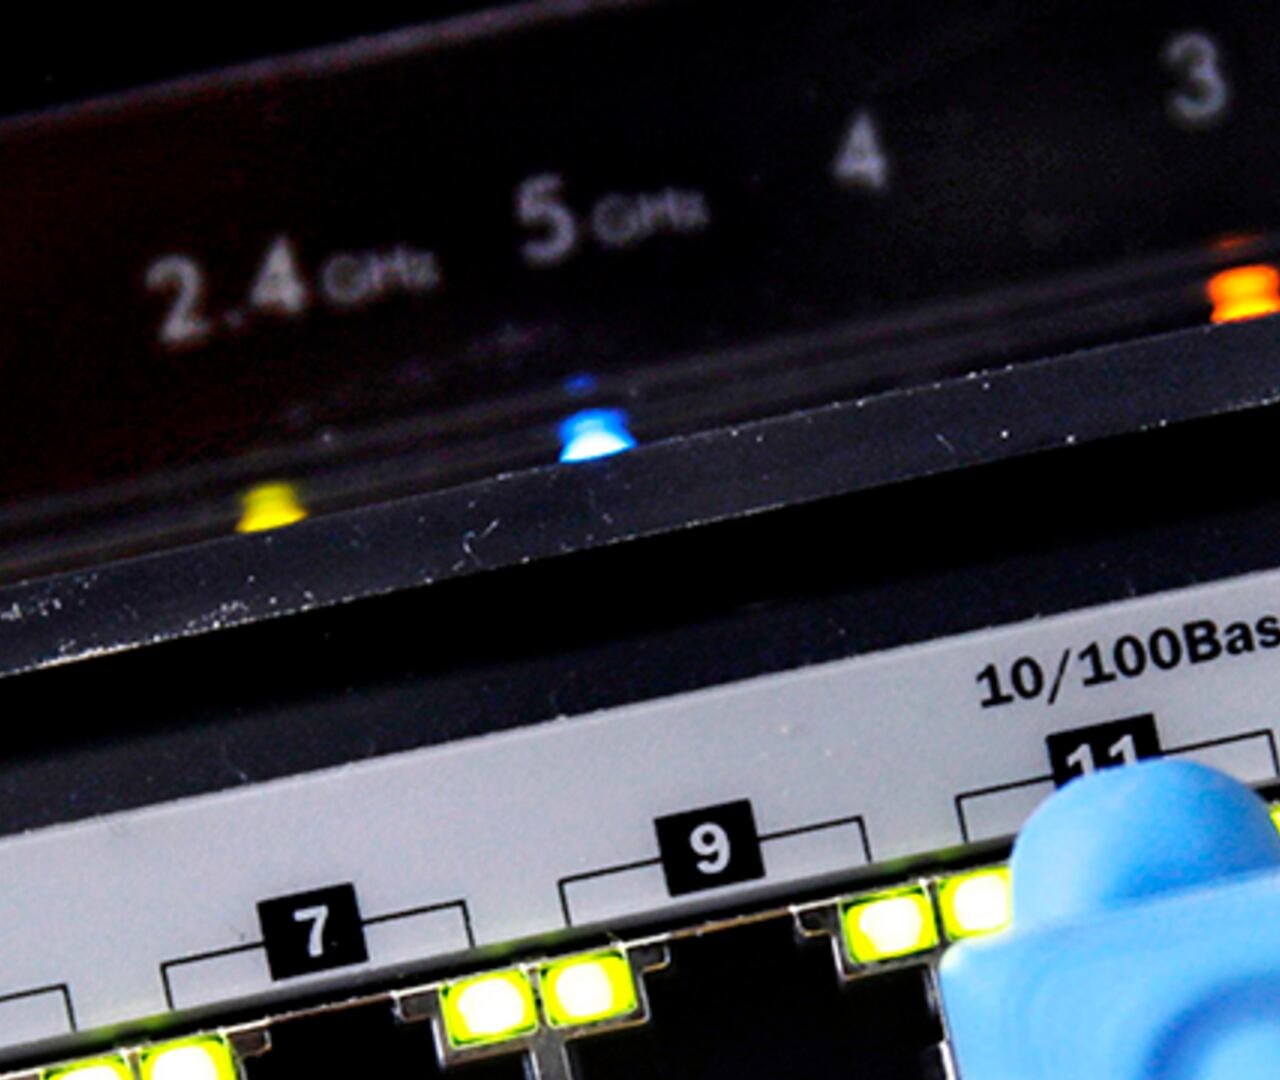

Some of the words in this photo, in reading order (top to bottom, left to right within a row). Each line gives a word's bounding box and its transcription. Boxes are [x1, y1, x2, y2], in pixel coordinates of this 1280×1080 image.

[1167, 32, 1229, 123] 3
[834, 111, 888, 189] 4
[517, 174, 578, 262] 5
[144, 237, 307, 343] 2.4
[689, 822, 731, 874] 9
[293, 905, 330, 957] 7
